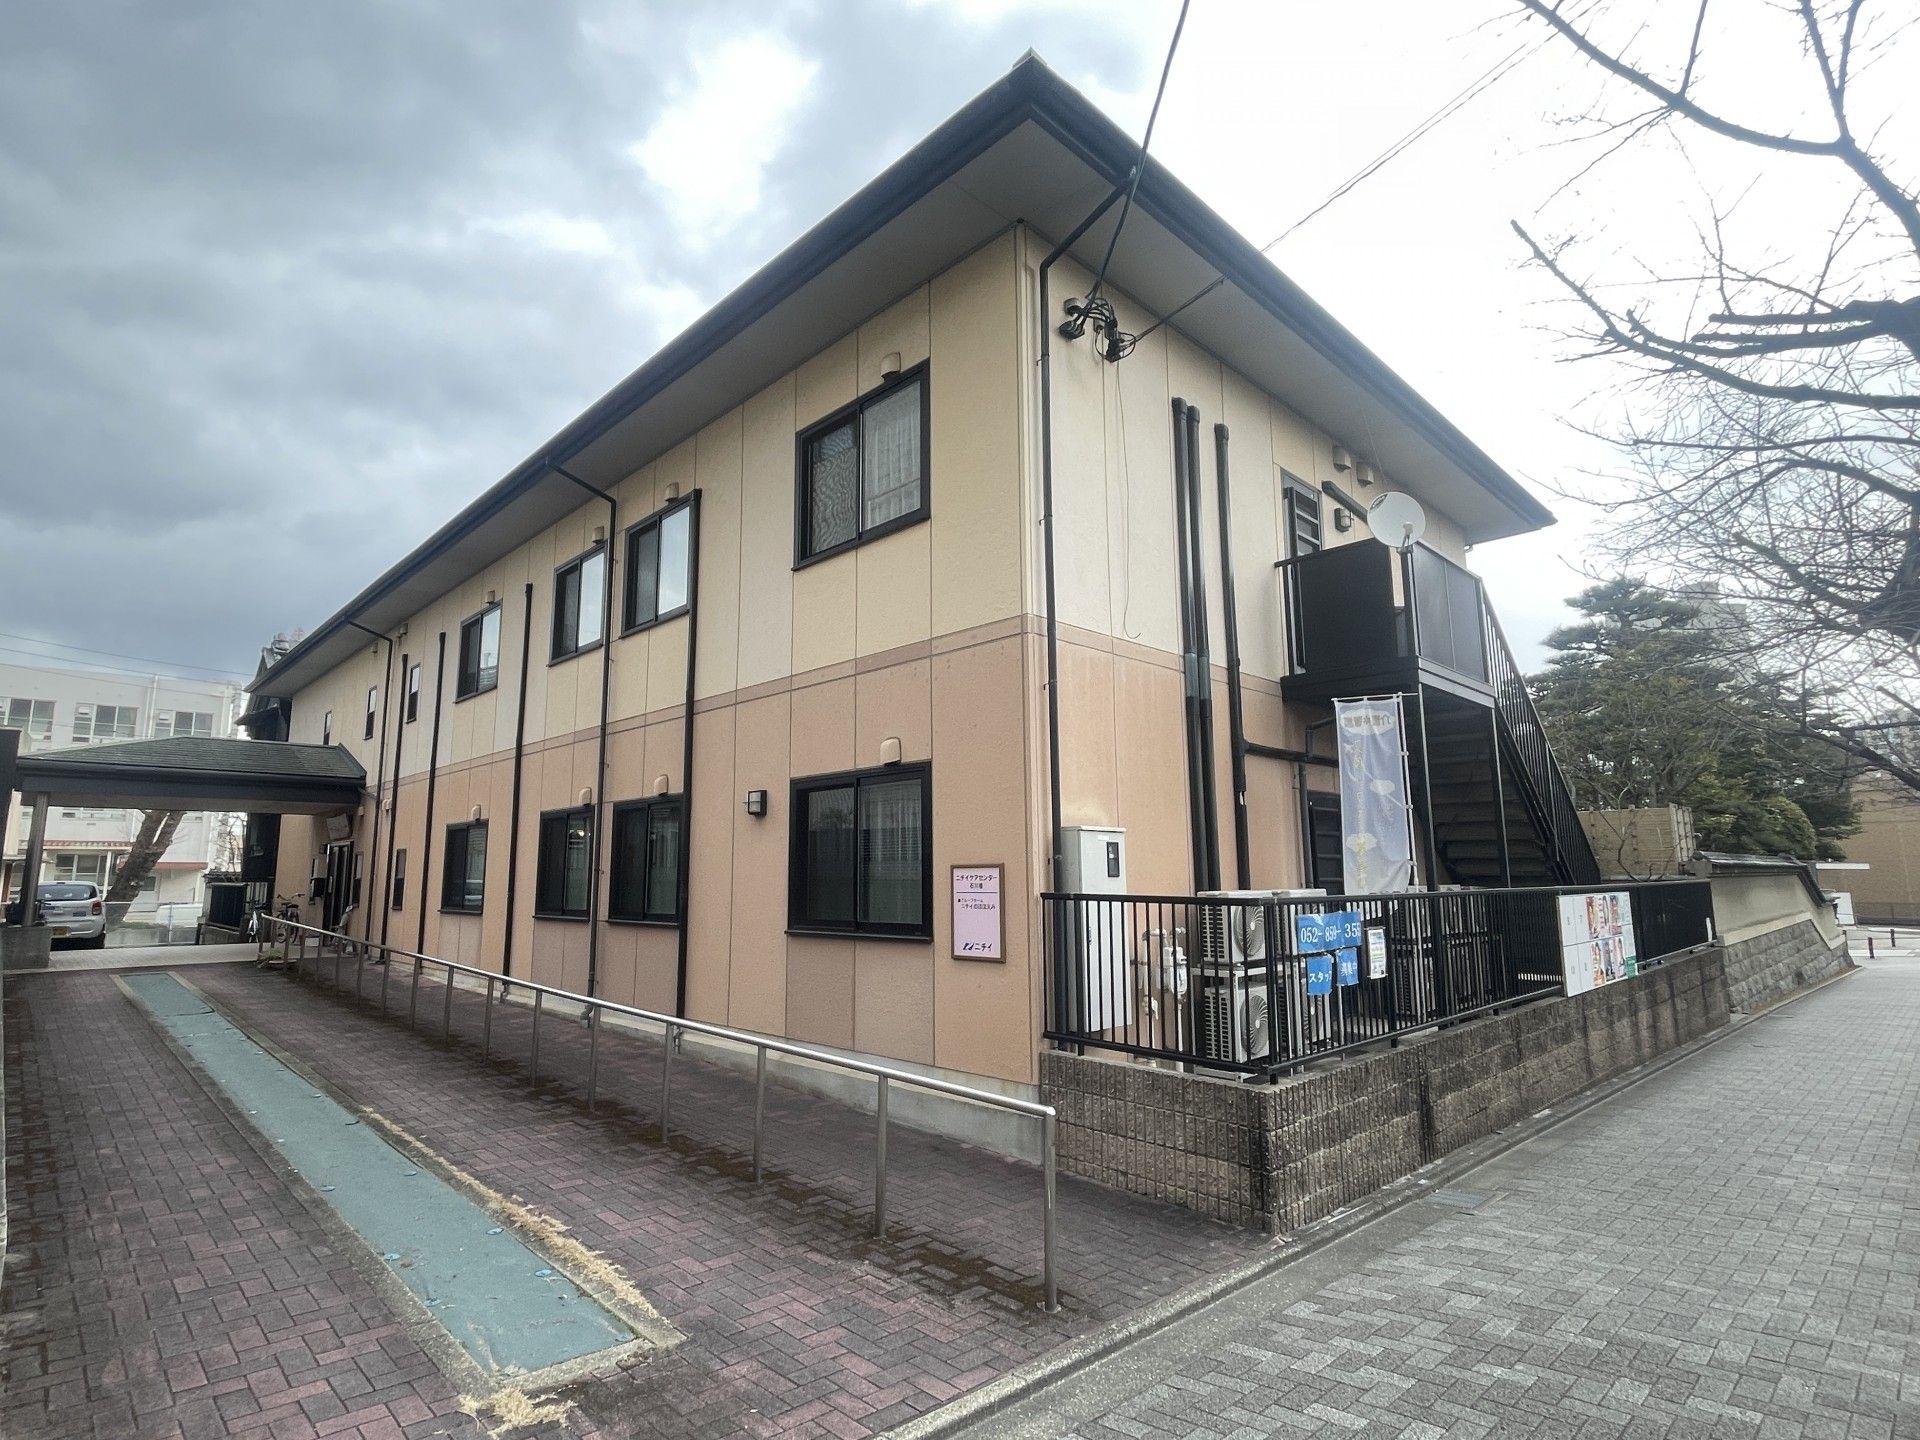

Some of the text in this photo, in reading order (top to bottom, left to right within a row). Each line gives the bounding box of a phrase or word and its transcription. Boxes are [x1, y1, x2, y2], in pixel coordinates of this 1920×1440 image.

[956, 874, 997, 882] ニチイケアセンター
[975, 942, 993, 952] ニチイ
